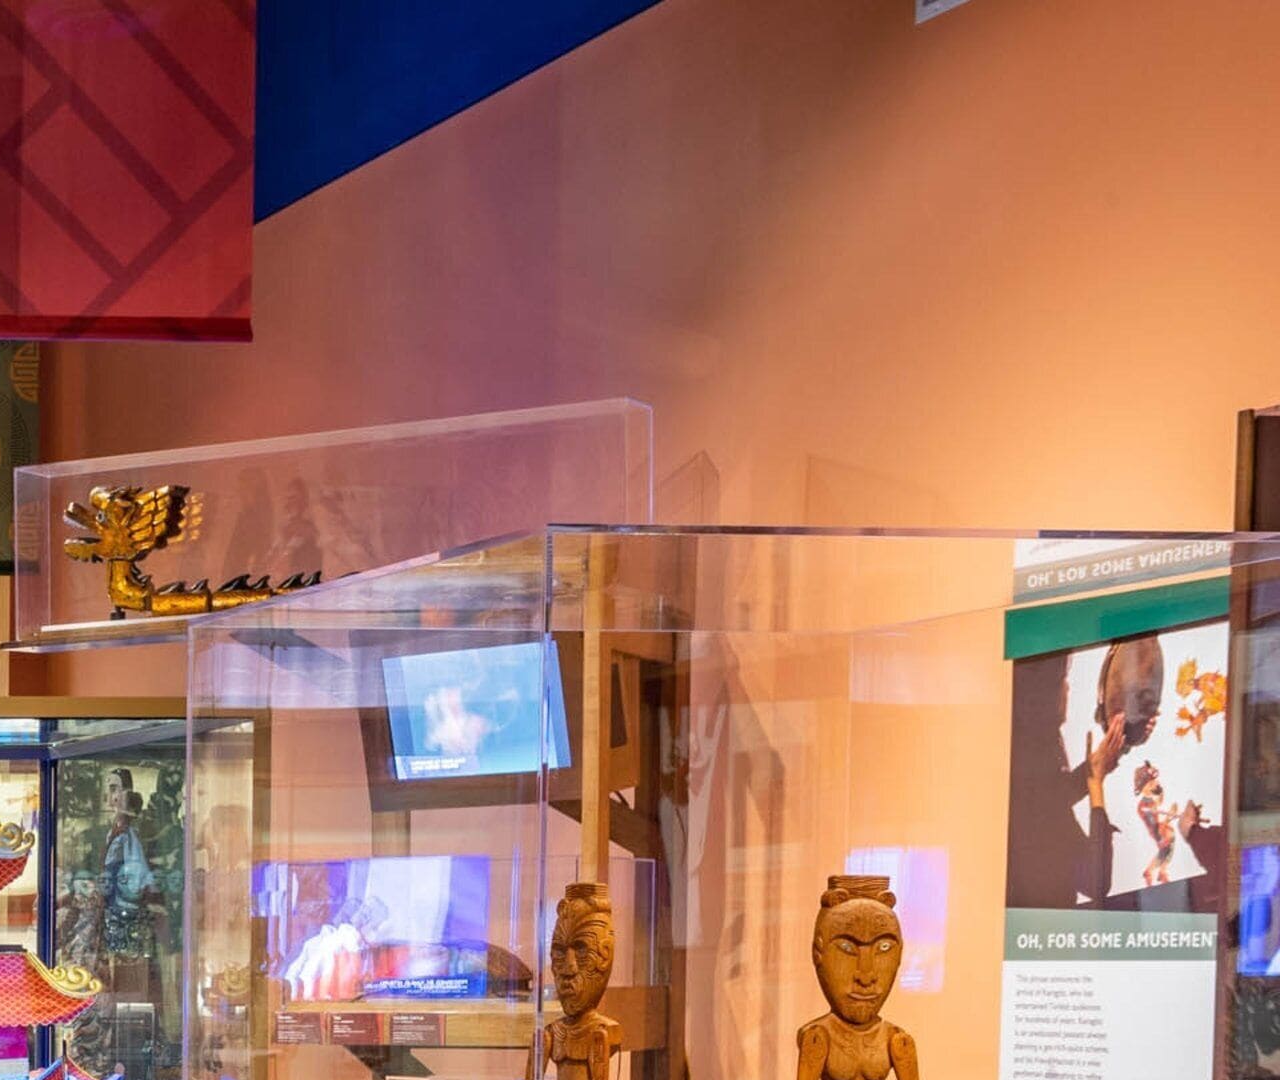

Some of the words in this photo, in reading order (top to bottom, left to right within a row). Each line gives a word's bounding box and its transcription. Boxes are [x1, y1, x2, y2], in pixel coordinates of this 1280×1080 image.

[1017, 934, 1043, 950] OH,
[1047, 934, 1076, 949] FOR
[1080, 933, 1121, 948] SOME
[1125, 931, 1217, 948] AMUSEMEN
